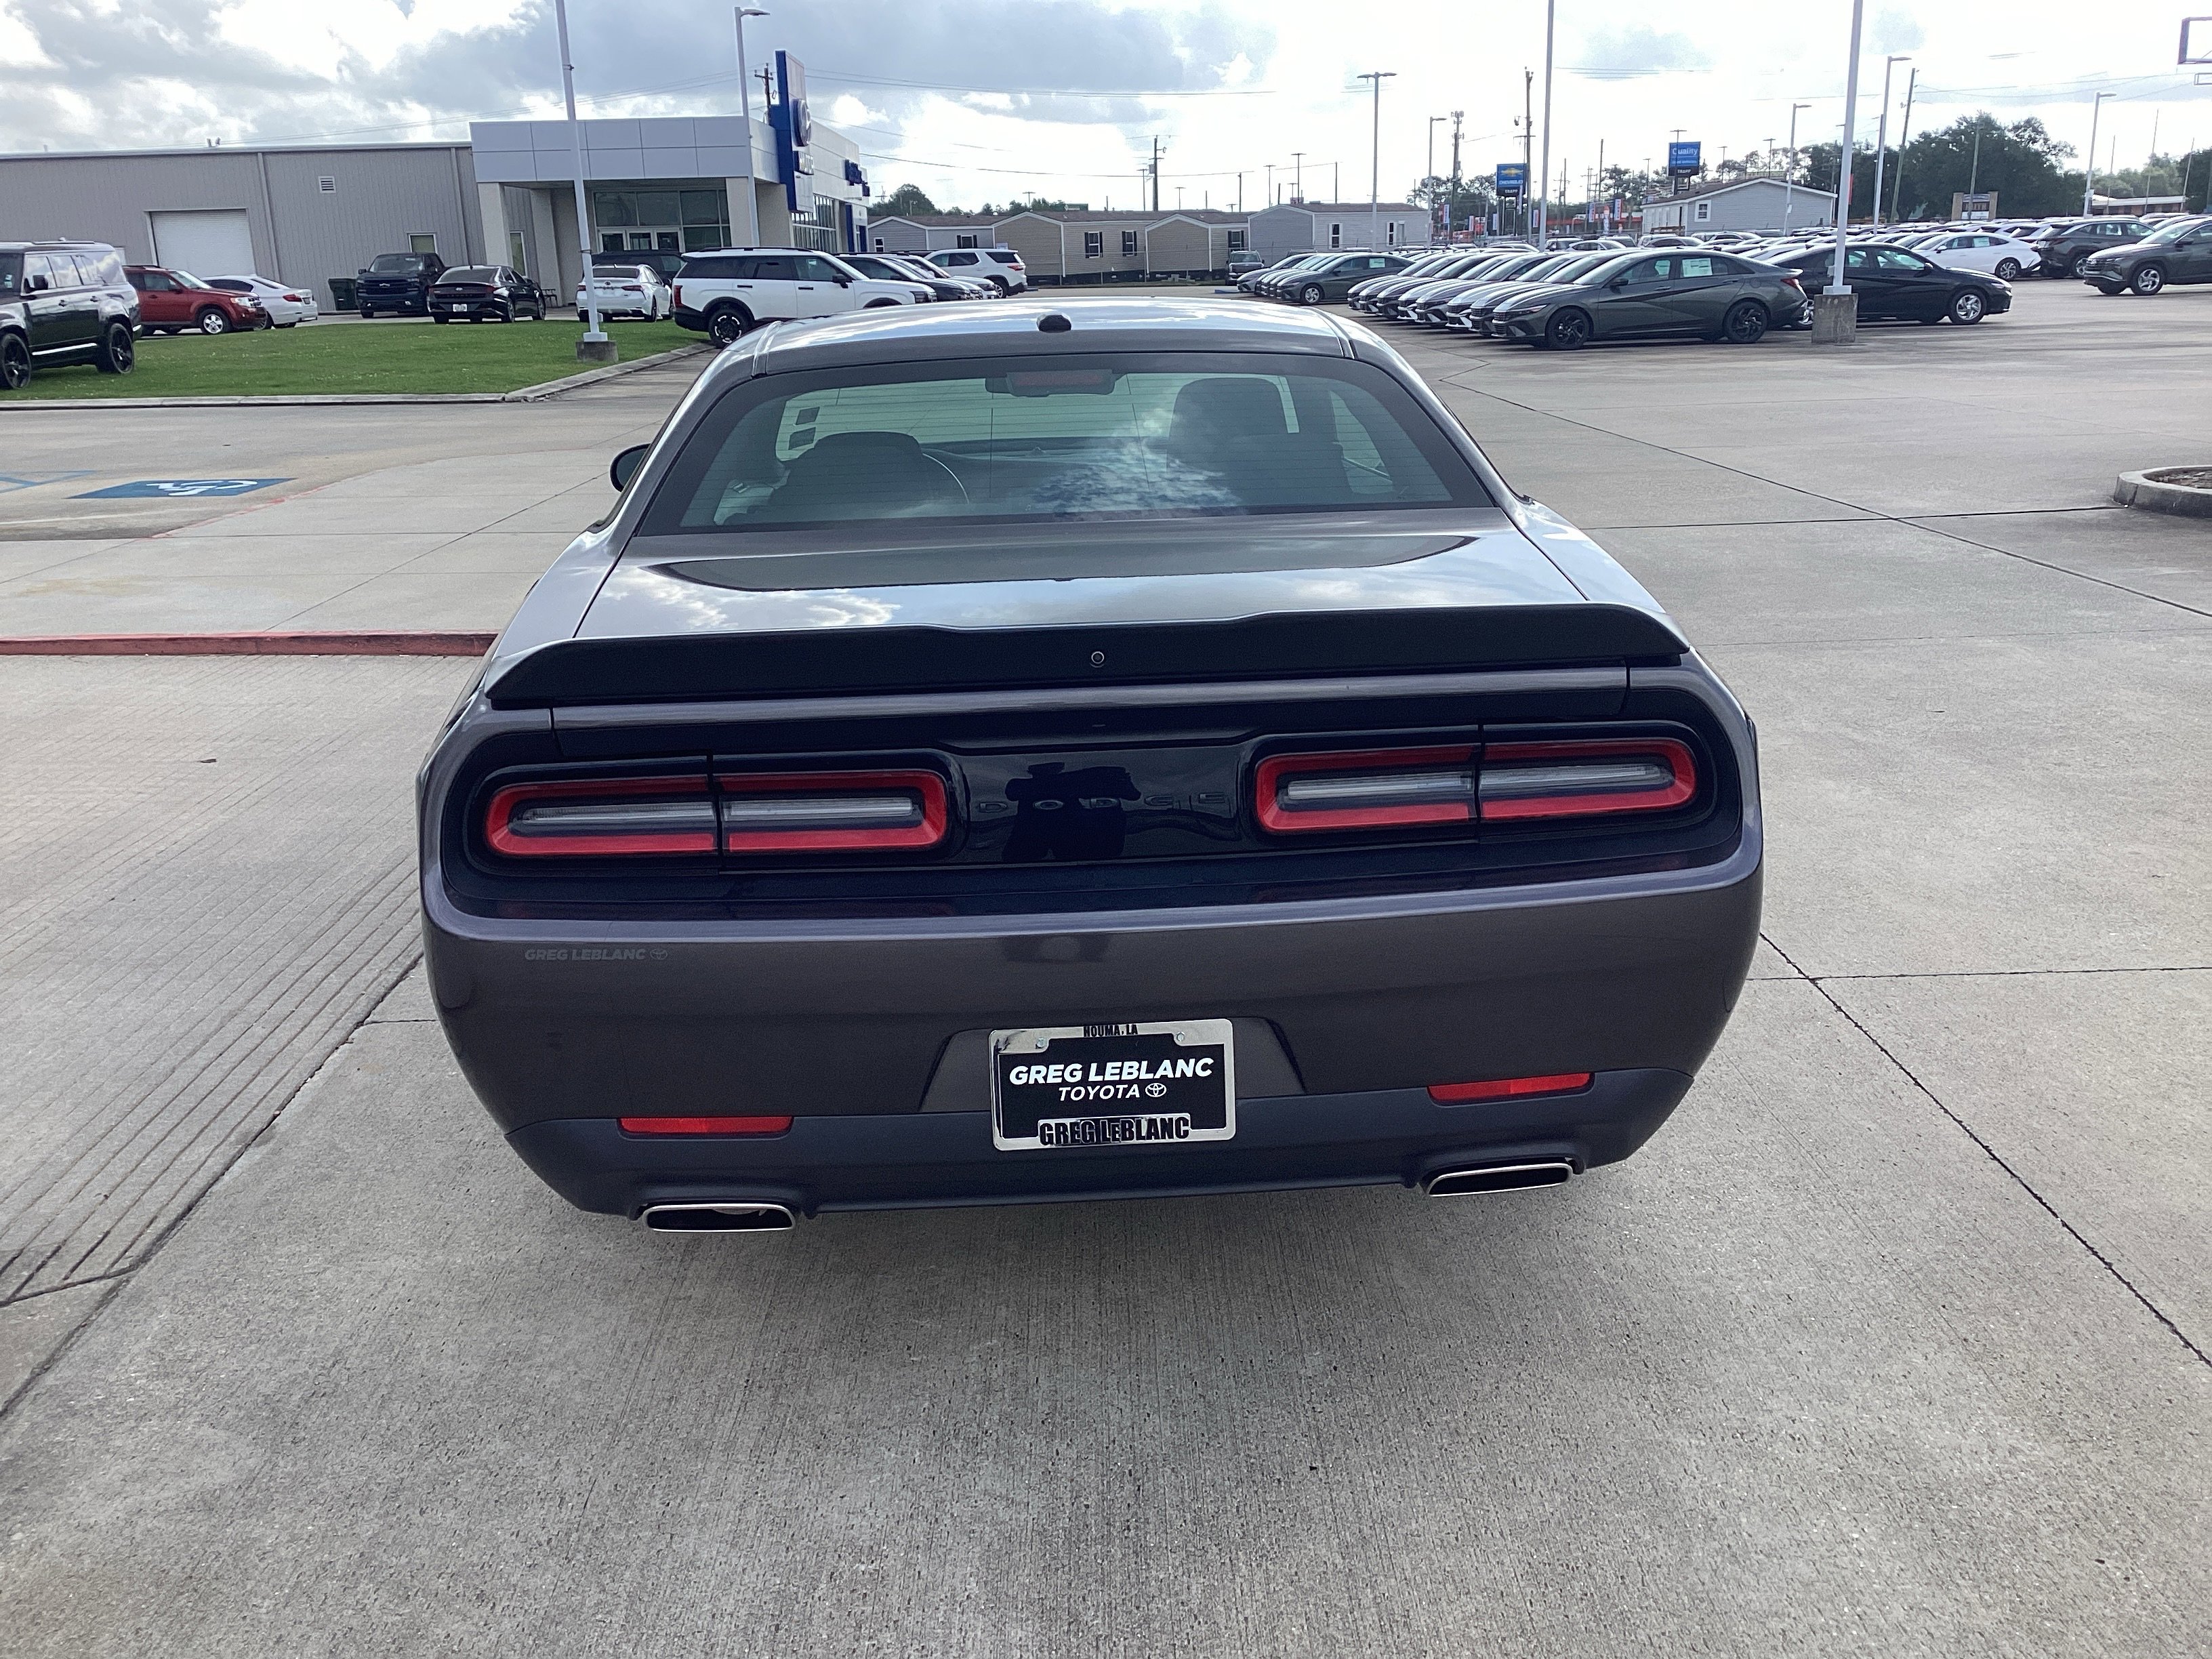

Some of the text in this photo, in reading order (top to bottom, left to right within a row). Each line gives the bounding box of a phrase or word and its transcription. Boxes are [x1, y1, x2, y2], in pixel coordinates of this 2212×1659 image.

[525, 948, 646, 961] GREG LEBLANC
[1009, 1057, 1214, 1085] GREG LEBLANC
[1059, 1084, 1140, 1101] TOYOTA
[1040, 1120, 1097, 1146] GREG
